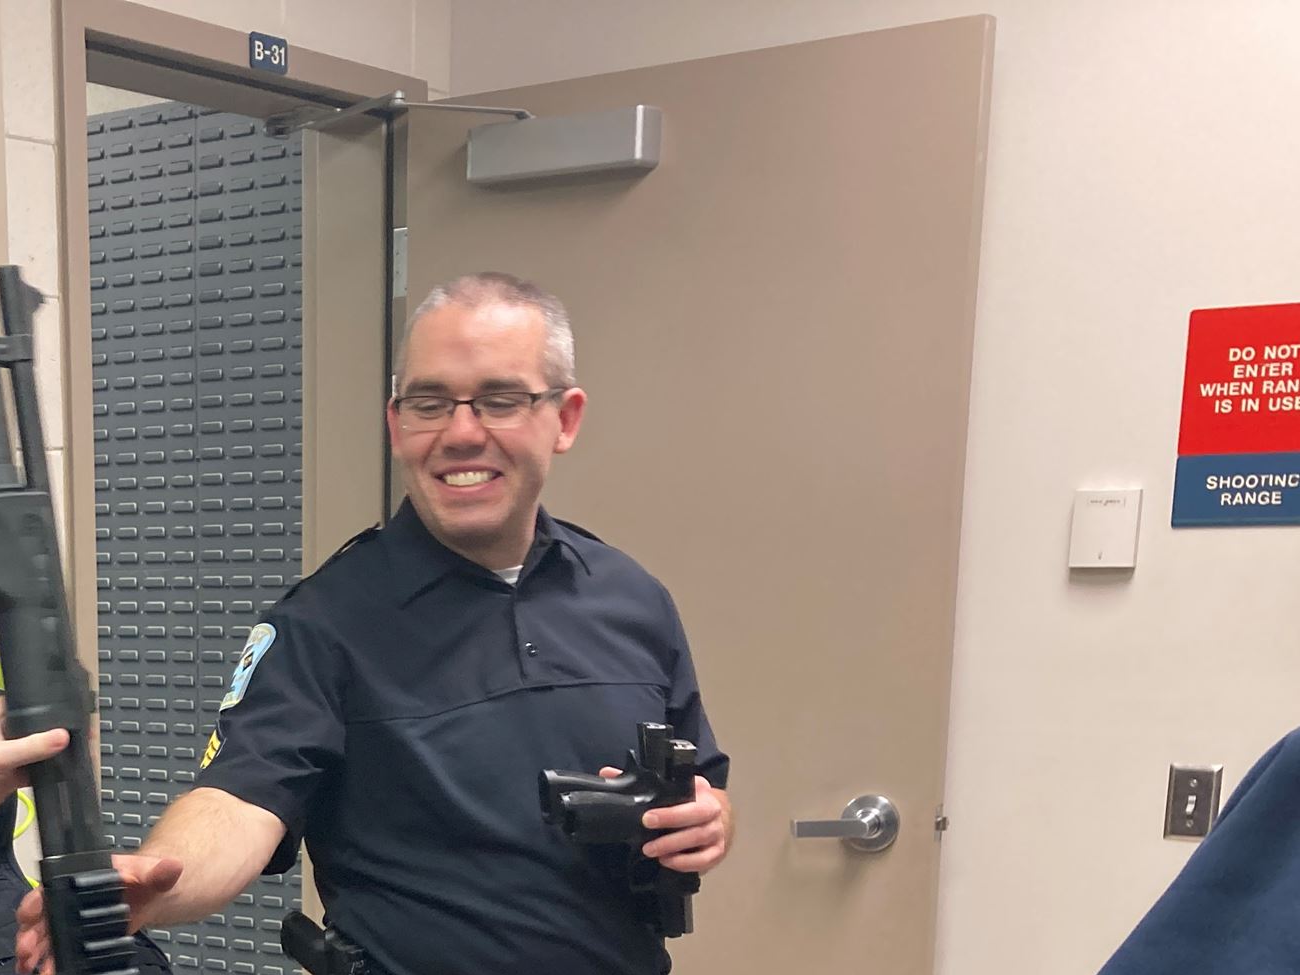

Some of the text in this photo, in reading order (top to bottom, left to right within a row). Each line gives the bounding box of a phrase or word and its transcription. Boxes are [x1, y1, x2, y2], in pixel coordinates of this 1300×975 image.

[254, 40, 285, 66] B-31
[1228, 343, 1300, 362] DO NOT
[1233, 361, 1294, 379] ENTER
[1199, 380, 1254, 397] WHEN
[1214, 398, 1233, 414] IS
[1241, 397, 1260, 412] IN
[1220, 490, 1283, 507] RANGE
